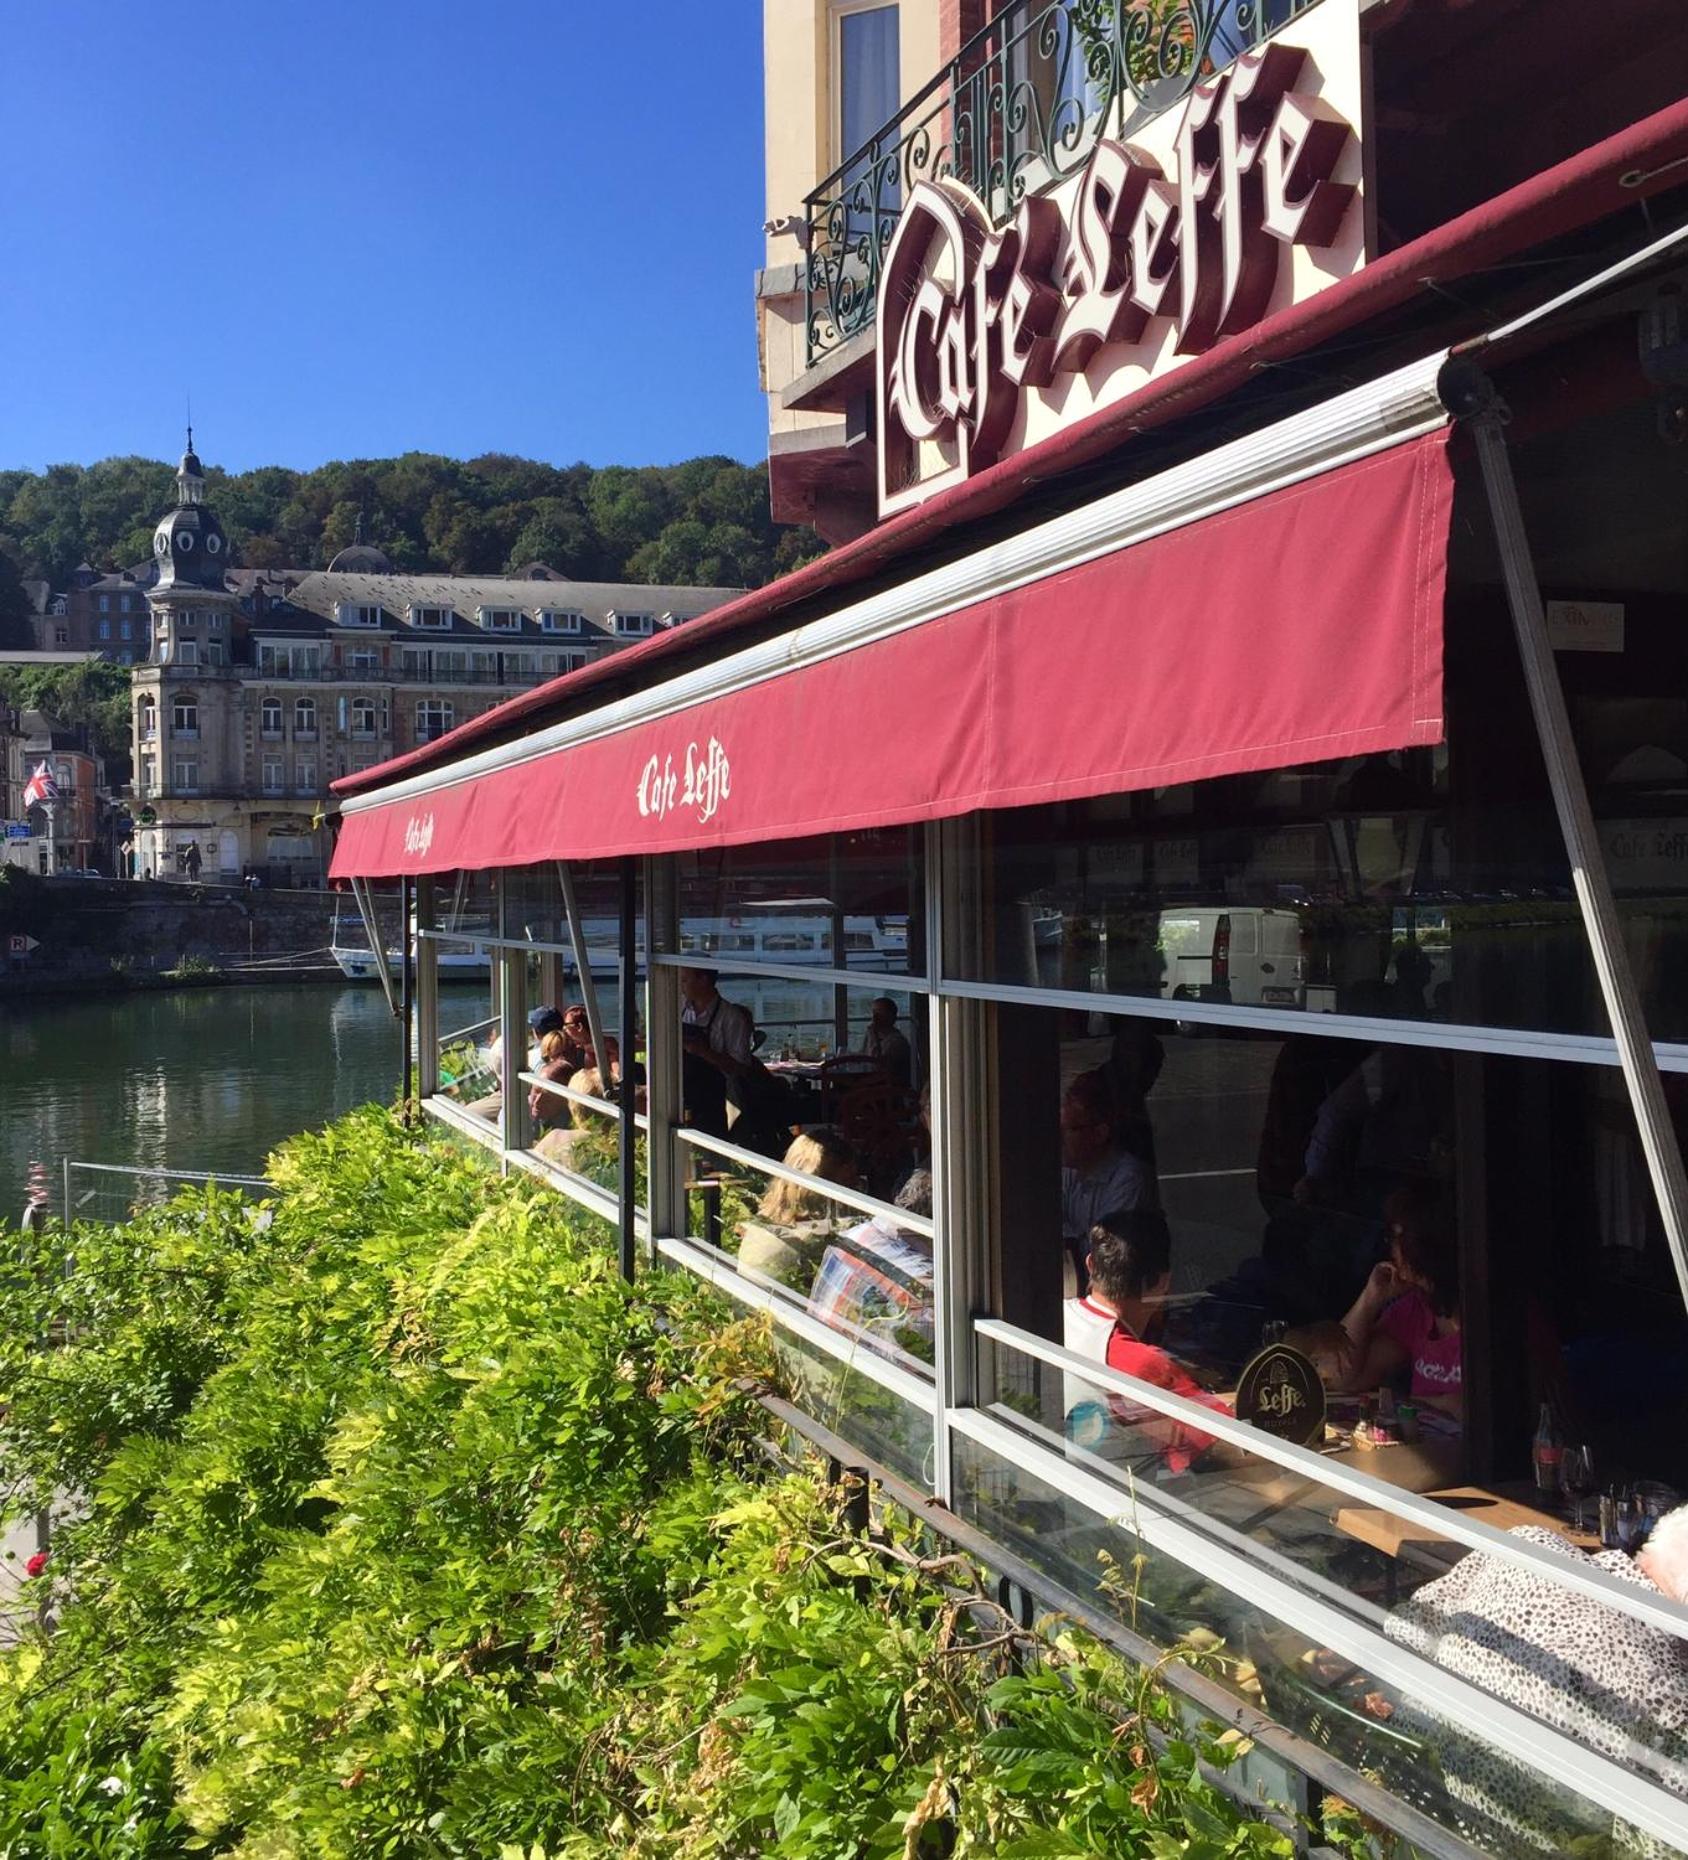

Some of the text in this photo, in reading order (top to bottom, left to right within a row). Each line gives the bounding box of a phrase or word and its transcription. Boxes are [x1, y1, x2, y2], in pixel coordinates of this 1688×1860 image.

[1050, 44, 1345, 371] Leffe
[637, 736, 730, 824] Cafe Leffe
[1256, 1384, 1303, 1417] Leffe
